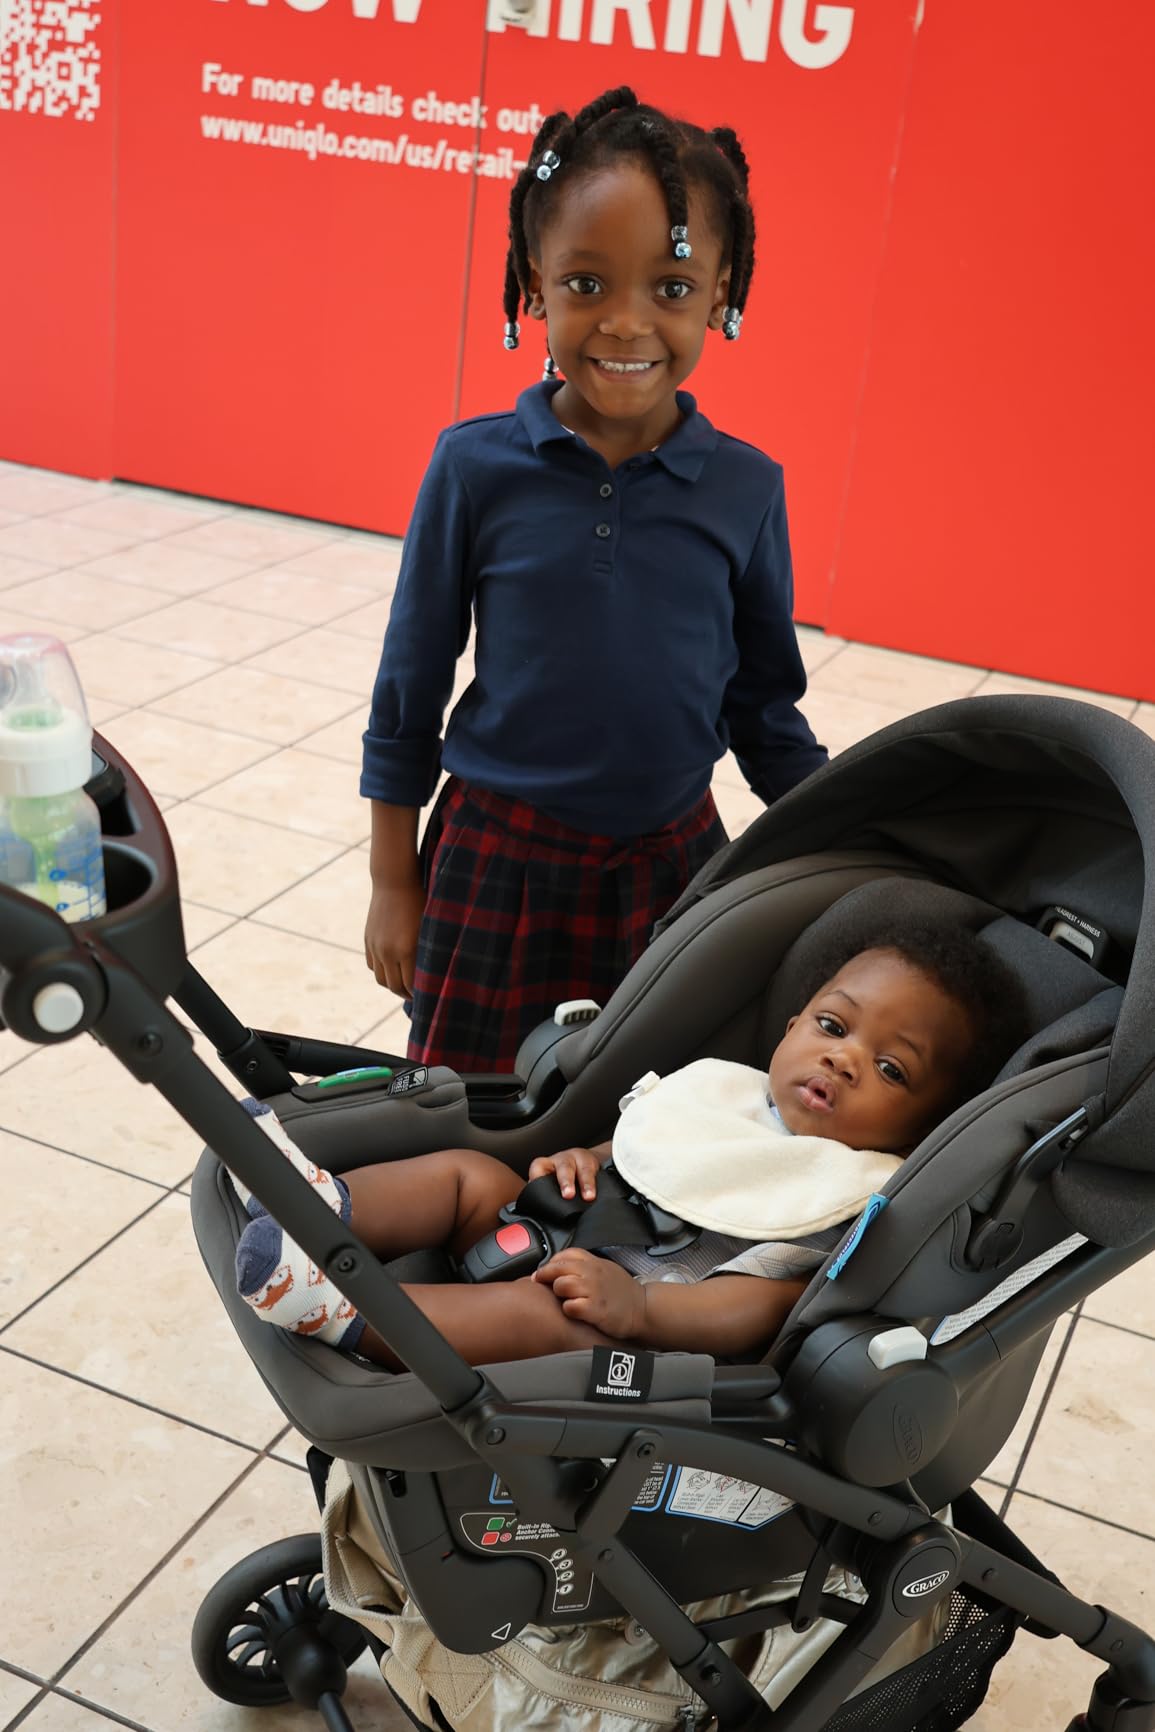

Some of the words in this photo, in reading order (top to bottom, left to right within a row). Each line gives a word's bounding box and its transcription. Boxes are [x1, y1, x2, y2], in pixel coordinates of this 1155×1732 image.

[202, 62, 244, 96] For
[252, 77, 315, 106] more
[322, 78, 404, 118] details
[411, 90, 489, 129] check
[1080, 920, 1101, 938] HARNESS
[596, 1384, 641, 1397] Instructions
[910, 1573, 946, 1594] GRACO
